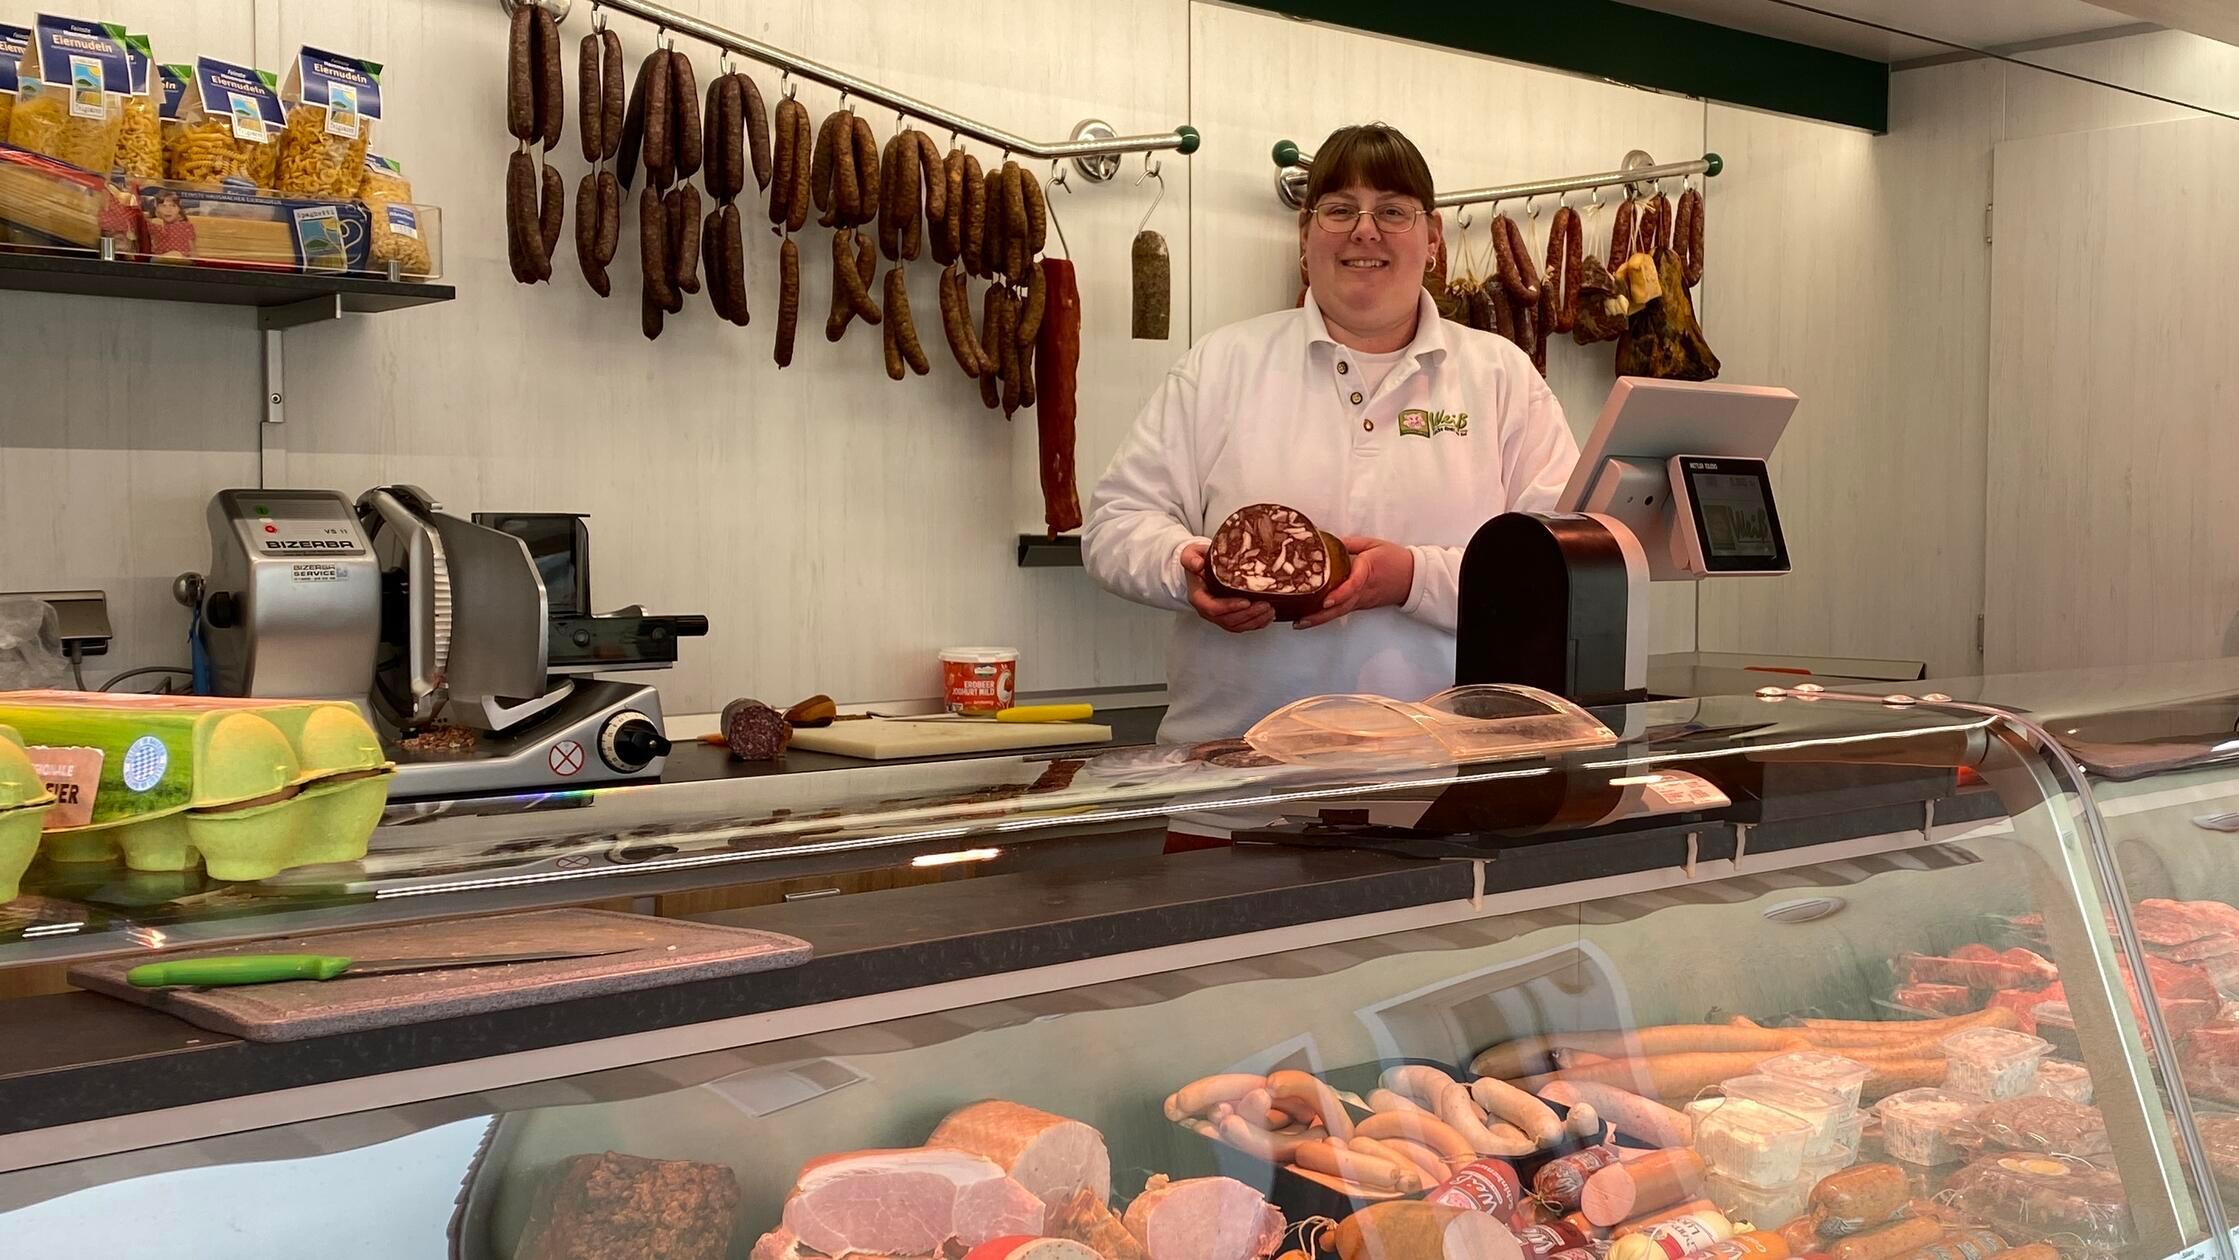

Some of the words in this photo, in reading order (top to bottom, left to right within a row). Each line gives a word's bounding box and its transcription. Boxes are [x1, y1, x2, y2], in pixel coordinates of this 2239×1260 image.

[52, 34, 113, 53] Eiernudeln
[313, 63, 368, 84] Eiernudeln
[211, 75, 266, 95] Eiernudeln
[265, 540, 354, 549] BIZERBA
[964, 680, 995, 688] ERDBEER
[979, 688, 995, 696] MILD
